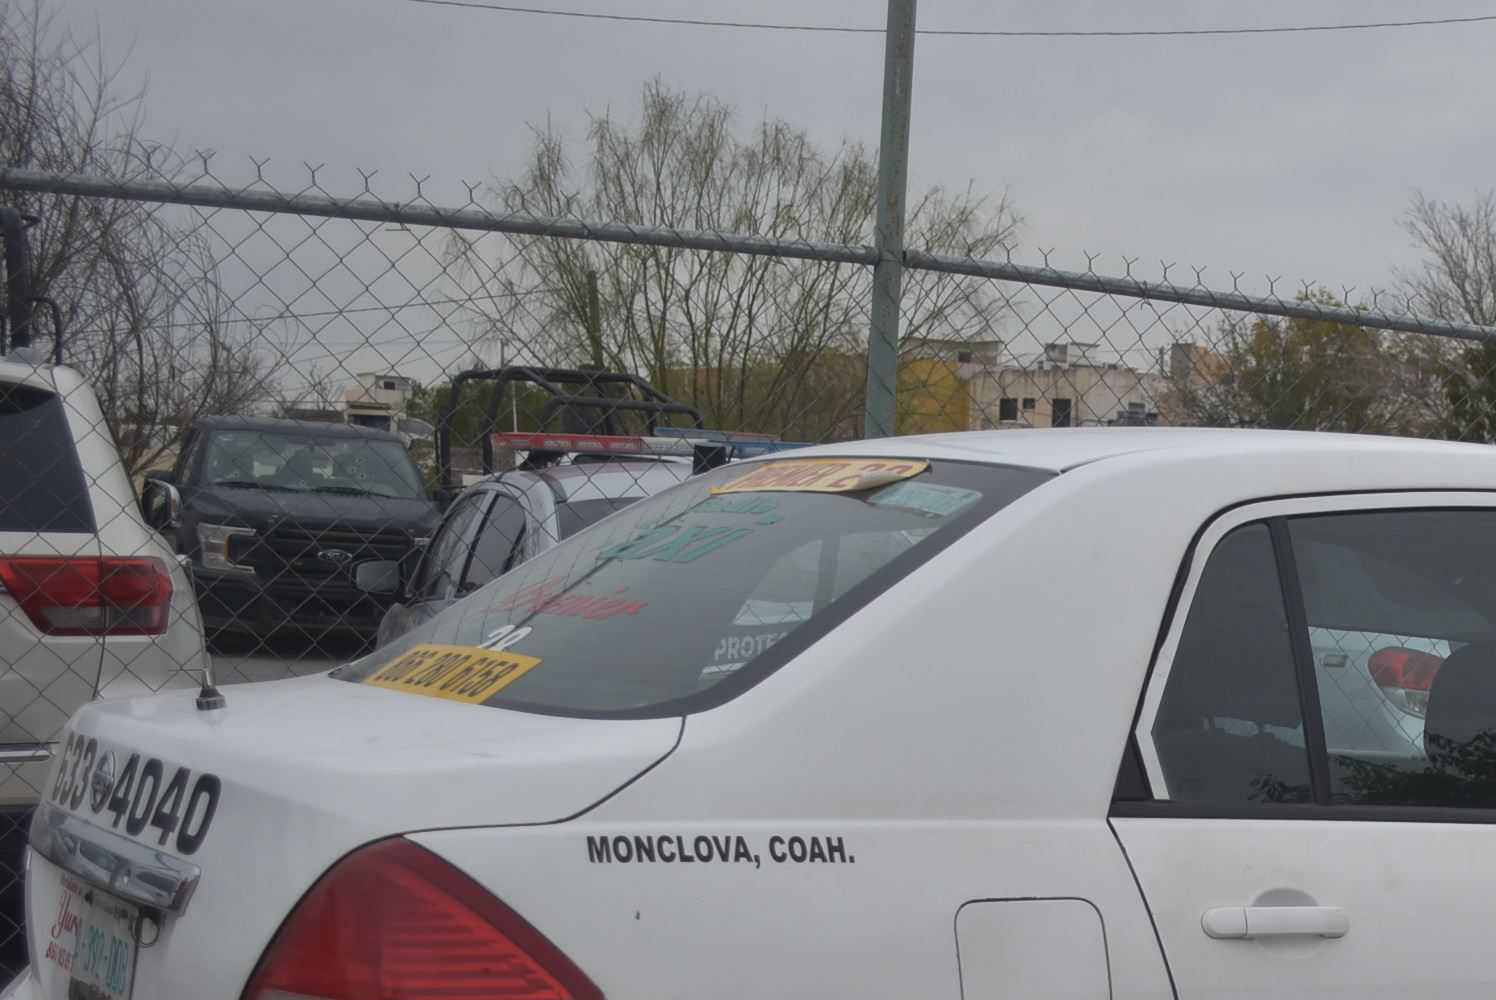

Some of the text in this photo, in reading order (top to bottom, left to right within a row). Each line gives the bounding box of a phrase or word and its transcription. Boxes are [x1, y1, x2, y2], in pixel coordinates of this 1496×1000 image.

[108, 753, 222, 855] 4040
[586, 835, 856, 869] MONCLOVA, COAH.
